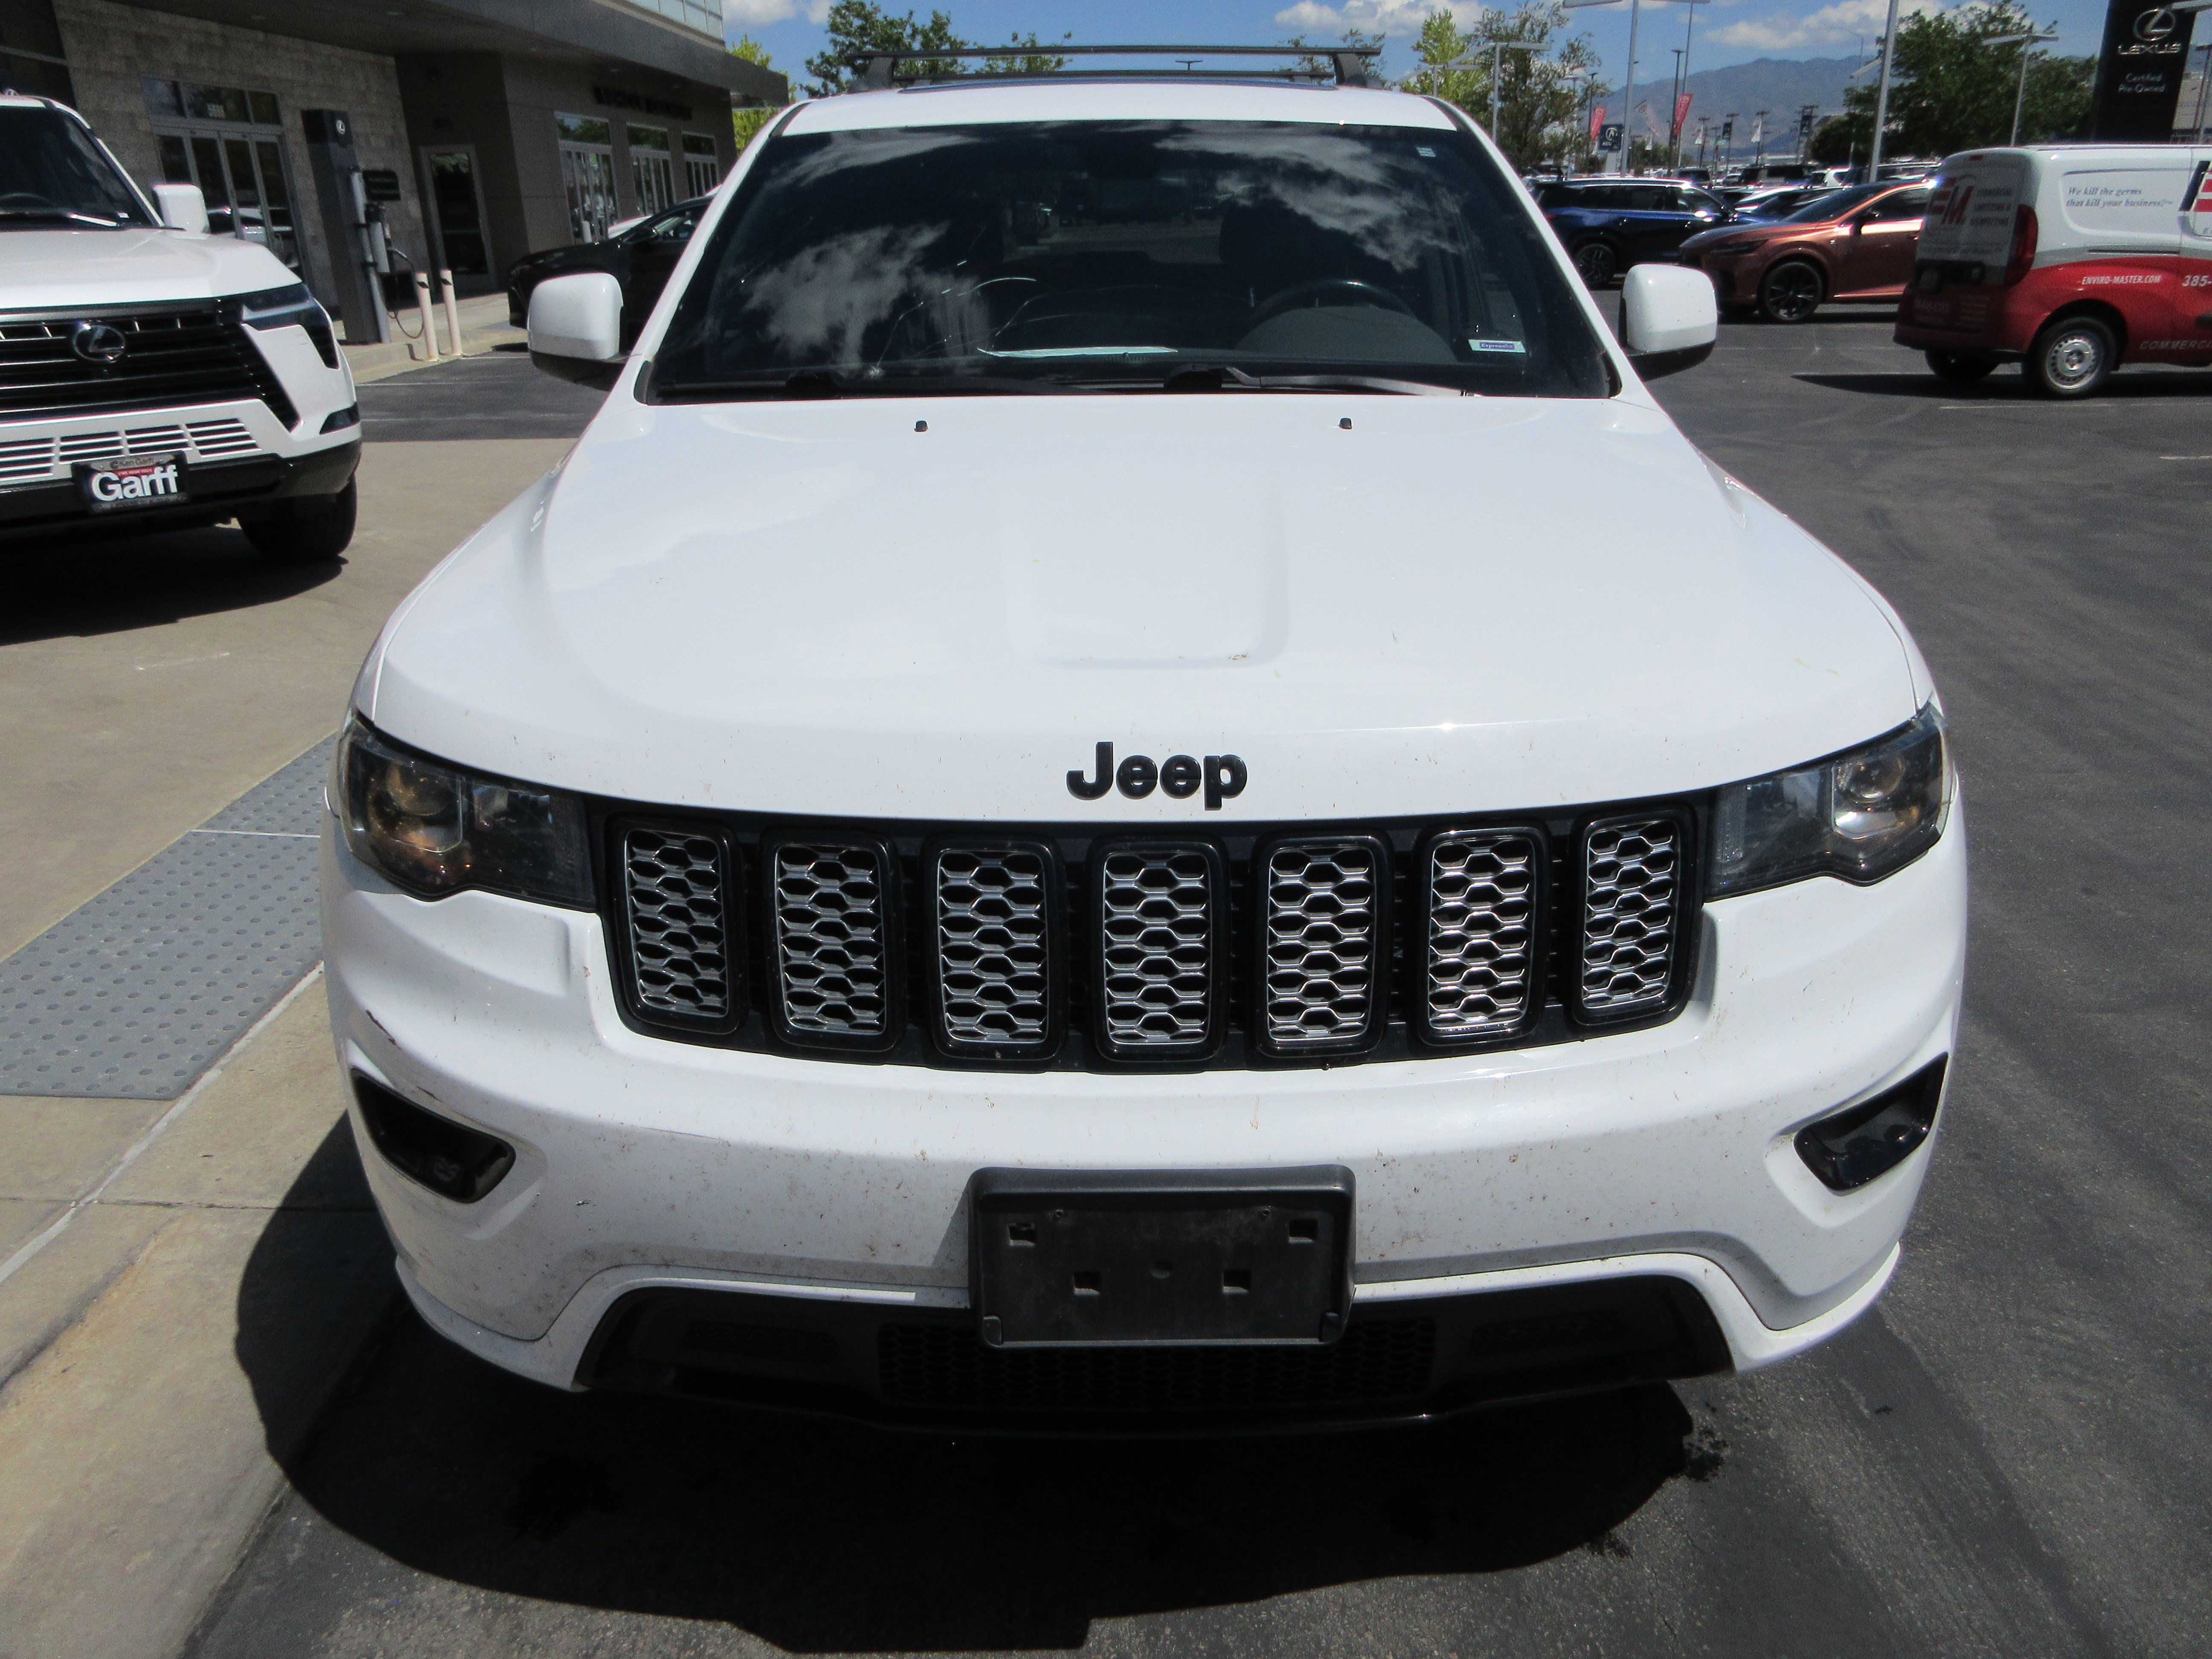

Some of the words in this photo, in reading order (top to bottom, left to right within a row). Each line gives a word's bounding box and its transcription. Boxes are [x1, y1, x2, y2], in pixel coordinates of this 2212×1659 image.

[2118, 43, 2182, 55] LEXUS
[2066, 199, 2084, 207] that
[2085, 199, 2101, 207] kill
[2100, 201, 2123, 209] your
[2082, 275, 2161, 285] ENVIRO-MASTER.COM
[91, 464, 178, 502] Garff
[1066, 741, 1248, 811] Jeep
